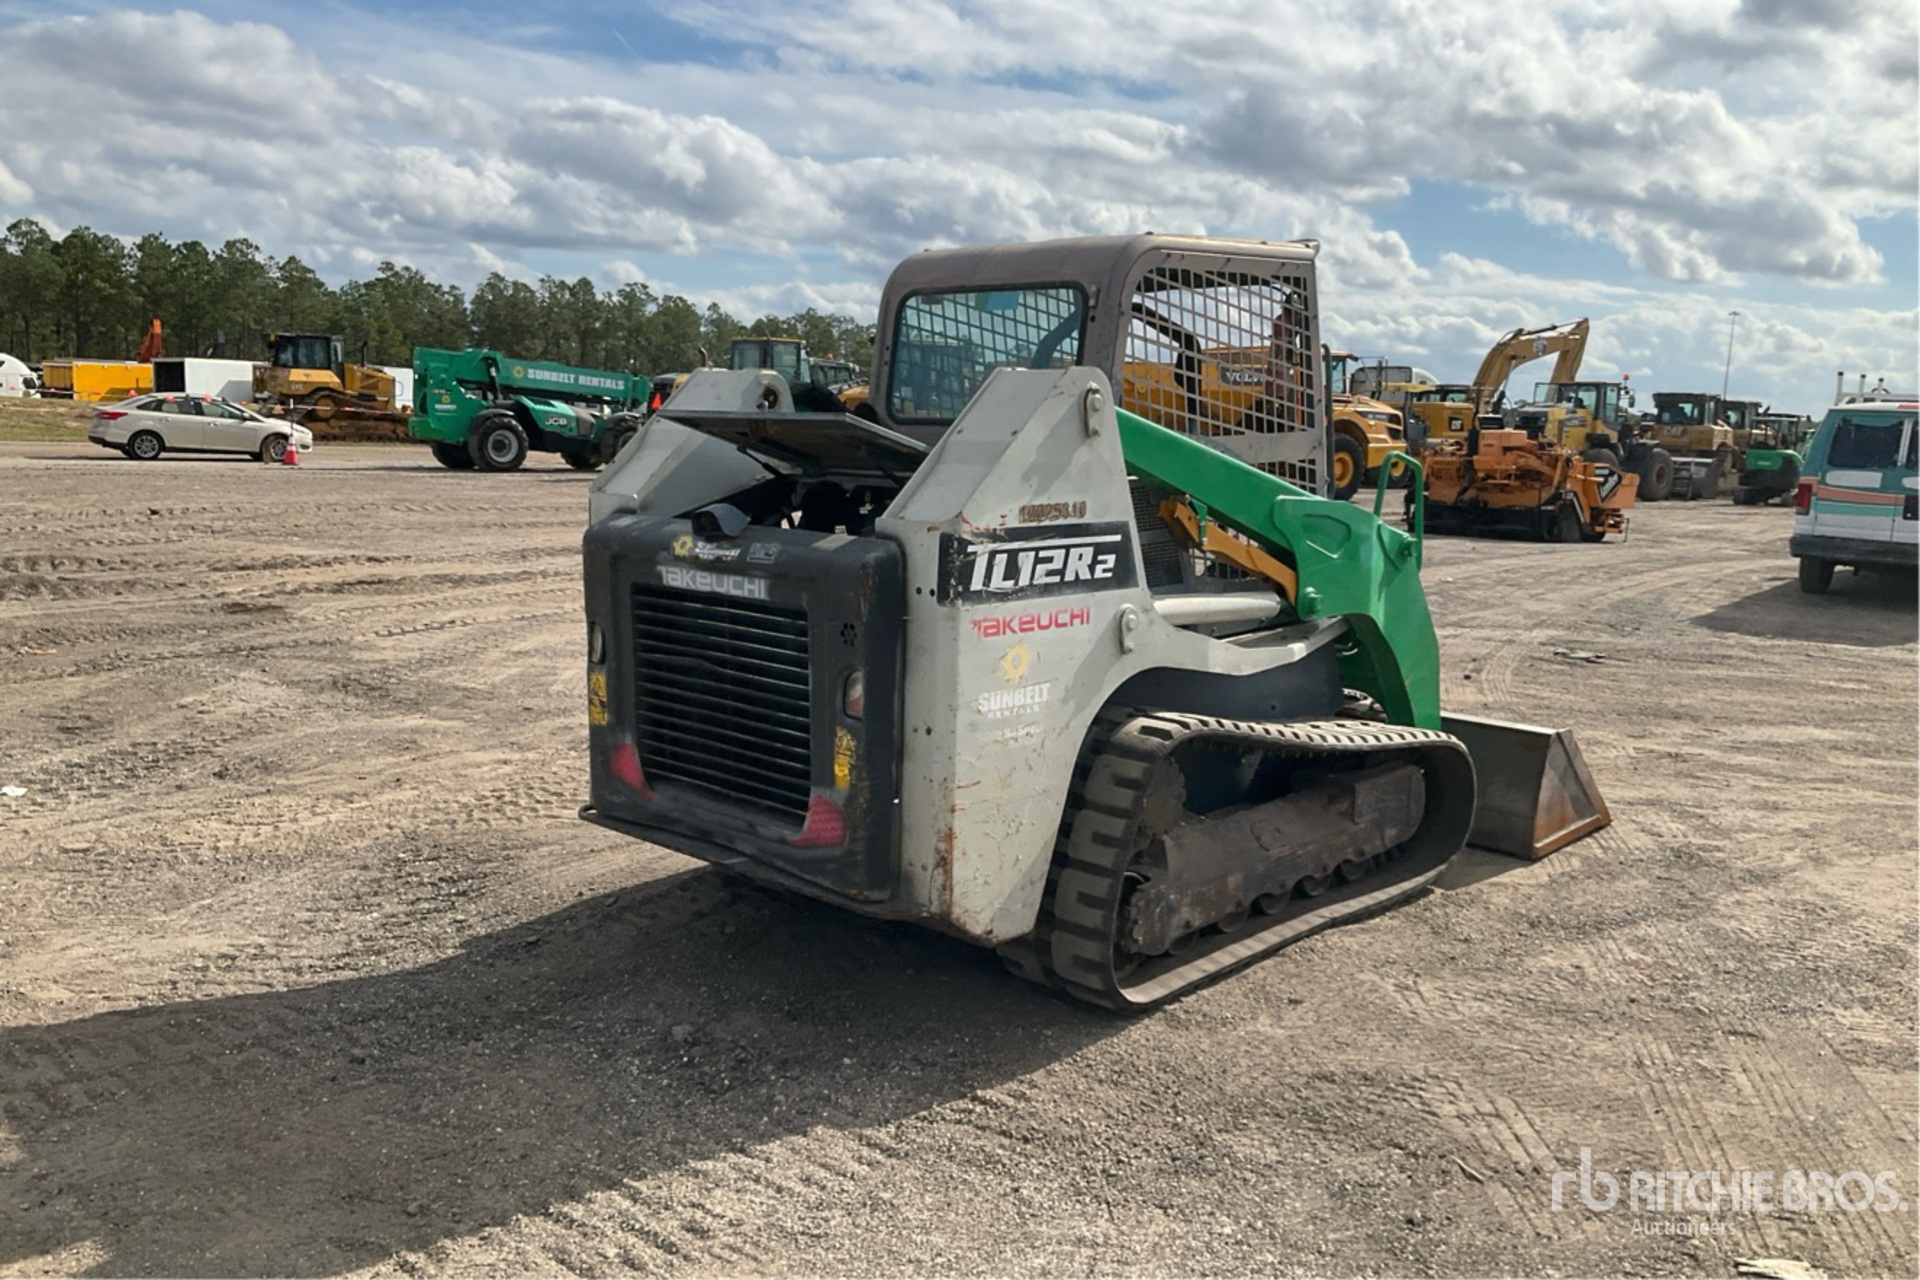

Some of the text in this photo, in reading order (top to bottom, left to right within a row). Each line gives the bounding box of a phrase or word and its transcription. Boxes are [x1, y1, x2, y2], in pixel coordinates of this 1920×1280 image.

[527, 368, 625, 390] SUNBELT RENTALS
[545, 417, 568, 426] JCB
[977, 683, 1051, 712] SUNBELT
